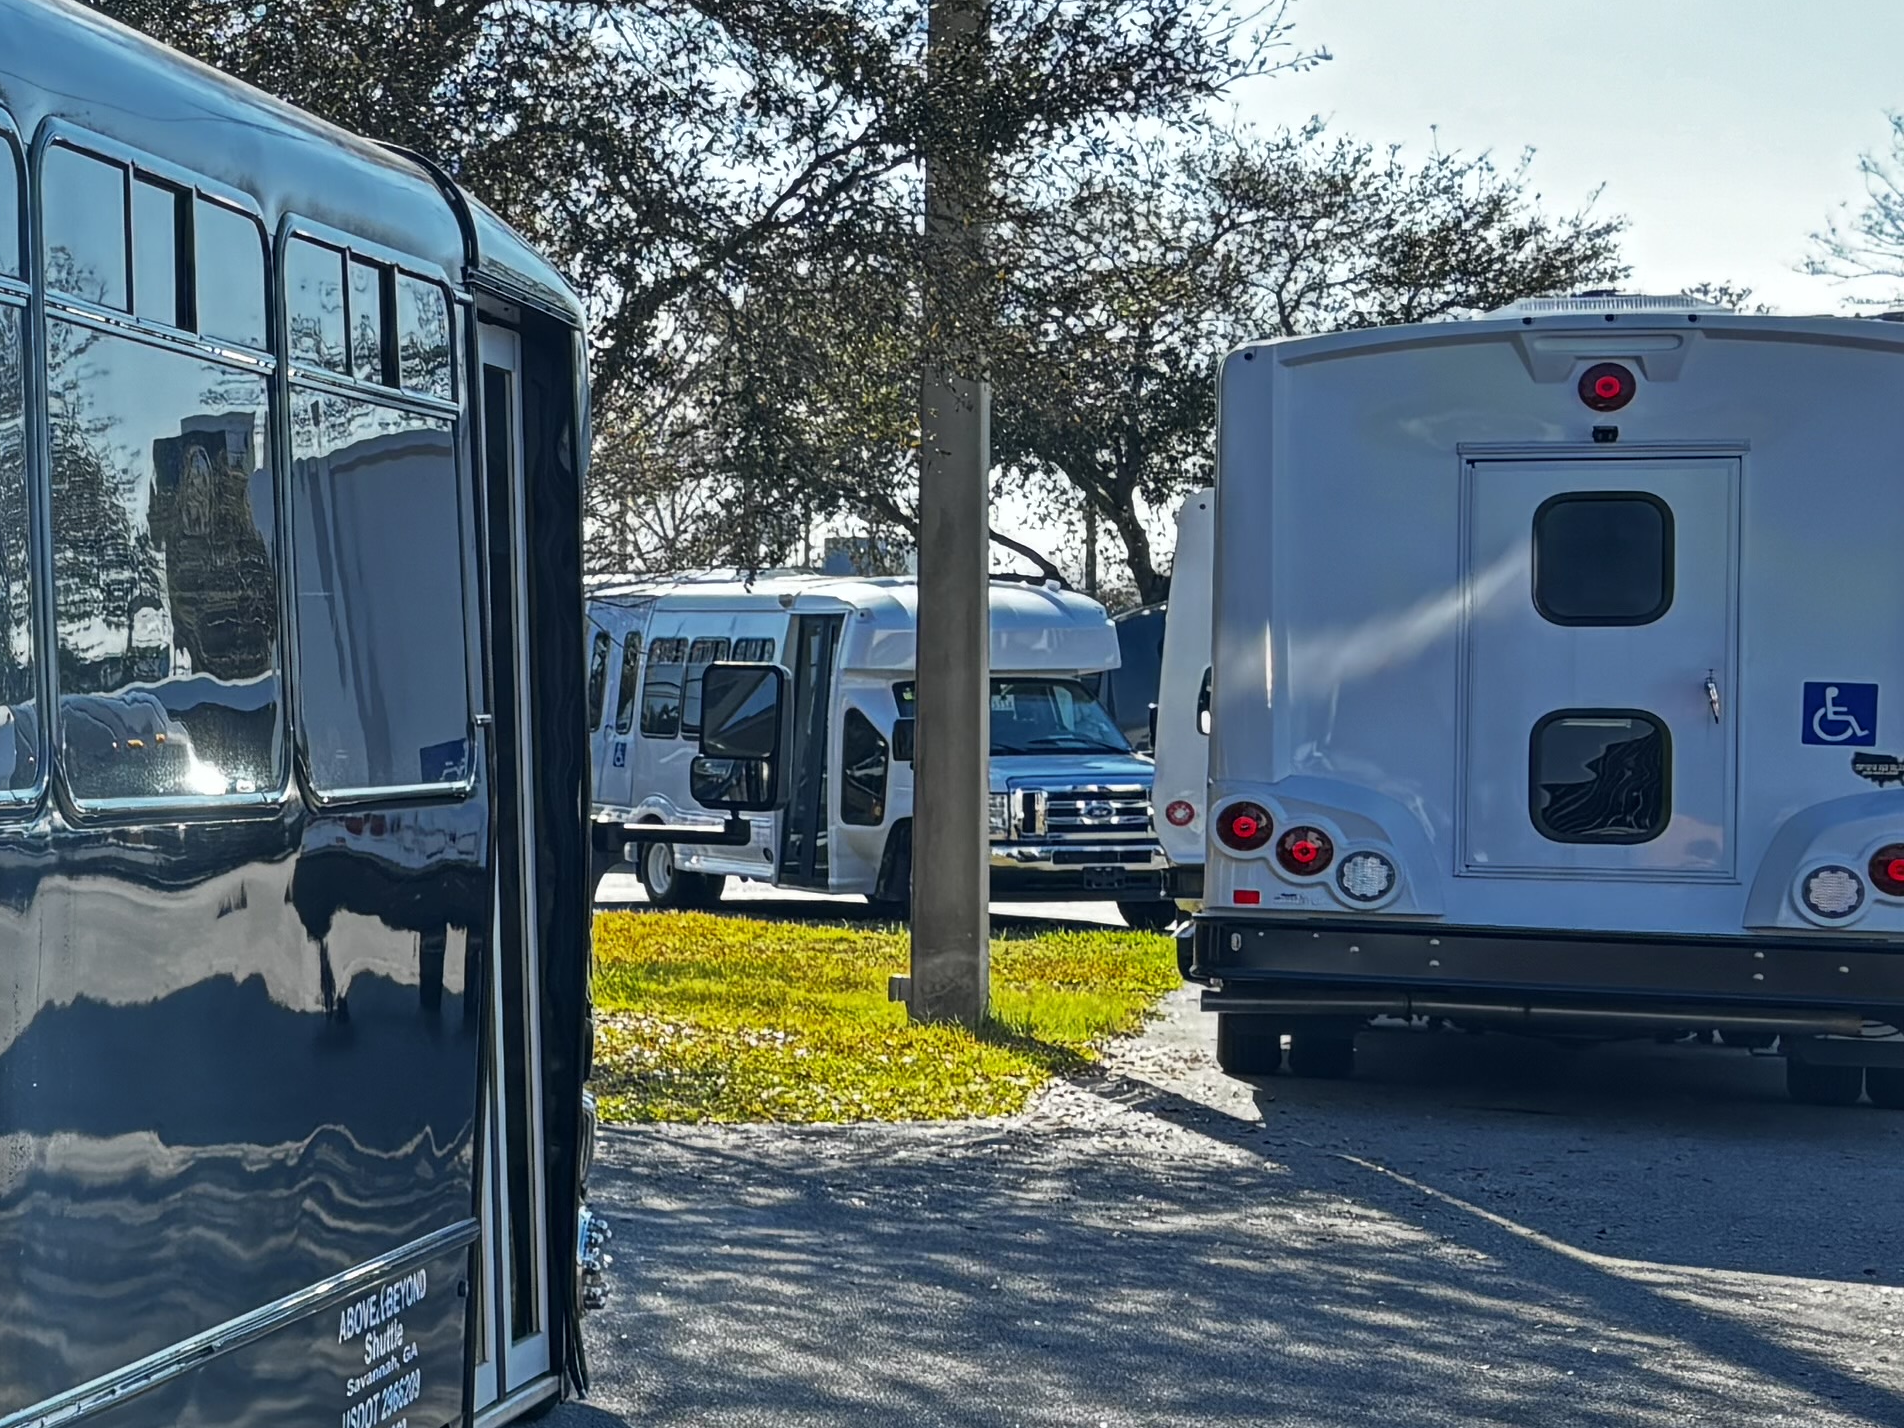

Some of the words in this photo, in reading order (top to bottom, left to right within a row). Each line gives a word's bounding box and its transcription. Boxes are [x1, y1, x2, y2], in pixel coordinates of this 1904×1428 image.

[338, 1294, 377, 1345] ABOVE
[386, 1268, 427, 1319] BEYOND
[364, 1318, 404, 1365] Shuttle
[403, 1341, 419, 1363] GA
